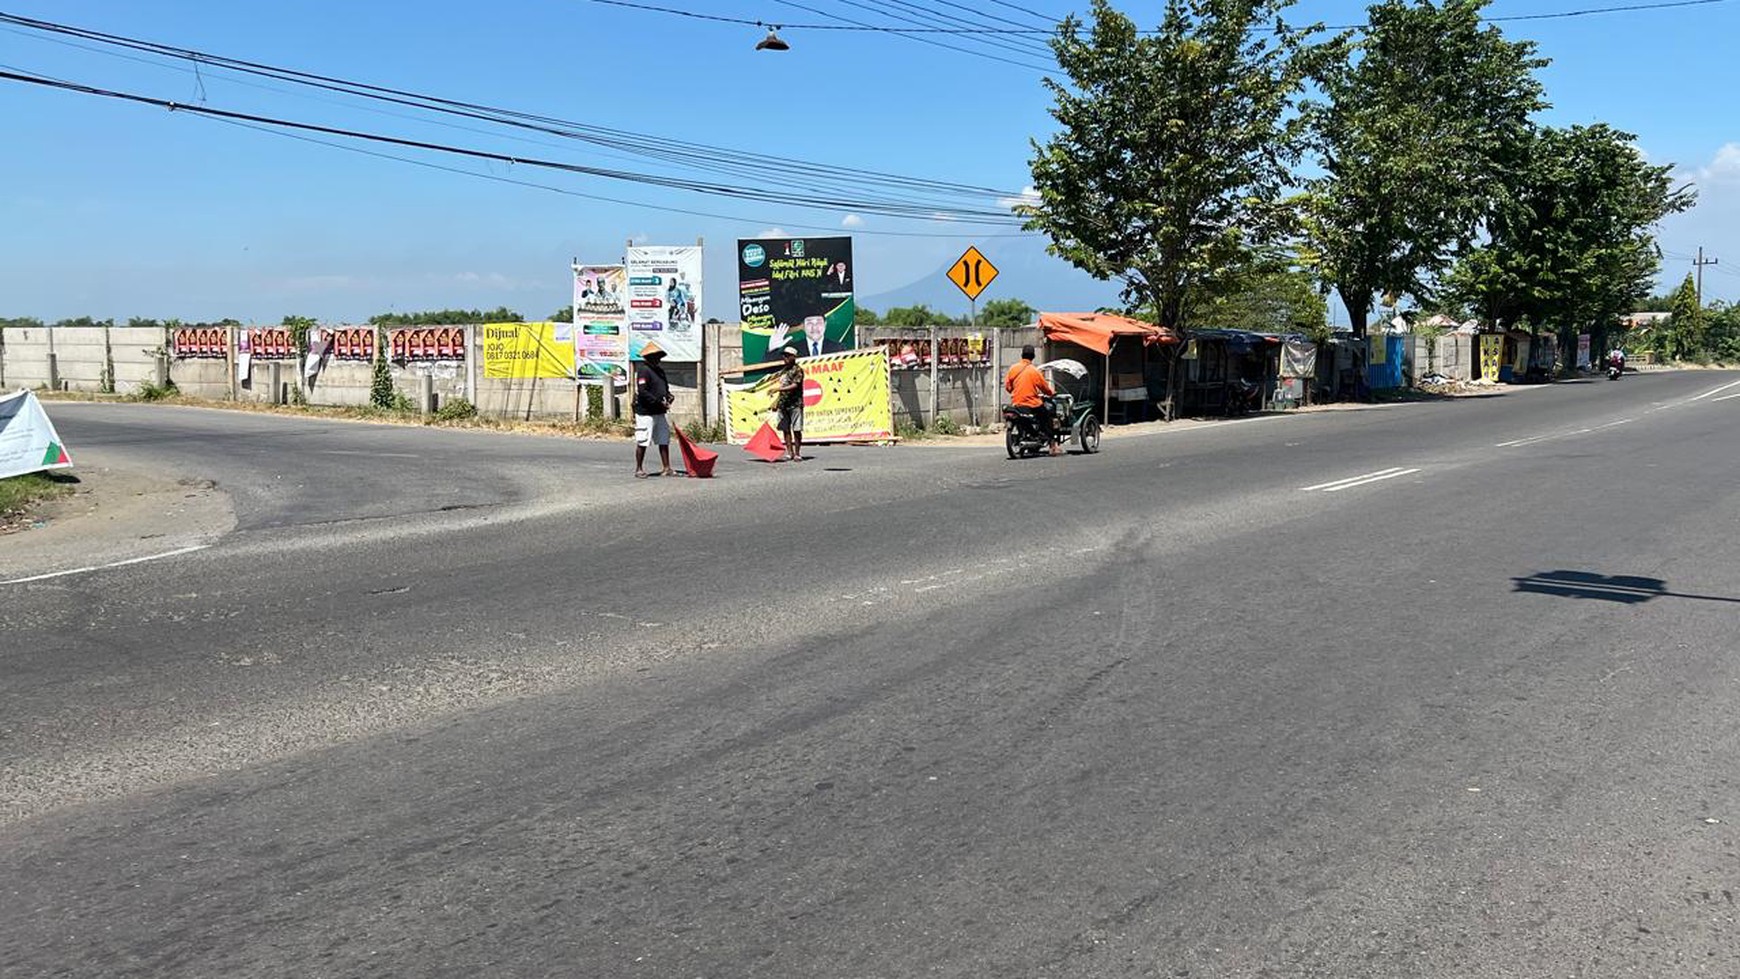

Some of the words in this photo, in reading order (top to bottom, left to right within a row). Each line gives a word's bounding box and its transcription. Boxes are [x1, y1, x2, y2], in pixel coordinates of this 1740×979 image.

[769, 258, 795, 270] Selamat
[795, 258, 810, 267] Hari
[784, 269, 799, 280] Fitri
[742, 303, 770, 316] Deso
[486, 327, 518, 340] Dijual
[811, 361, 845, 374] MAAF
